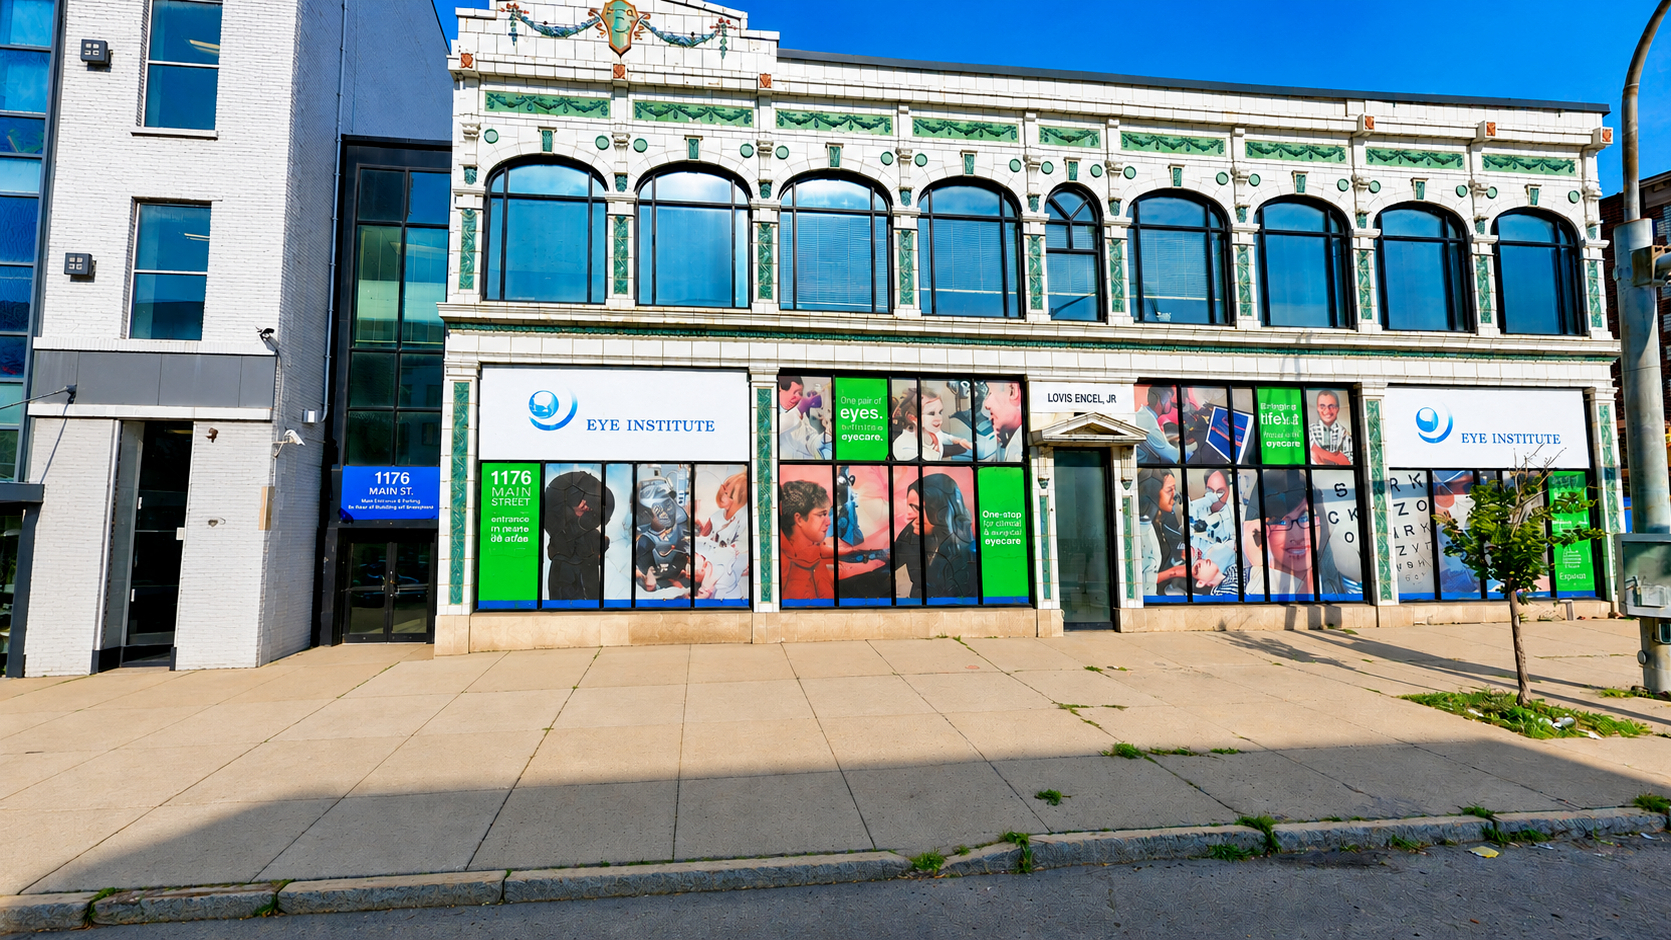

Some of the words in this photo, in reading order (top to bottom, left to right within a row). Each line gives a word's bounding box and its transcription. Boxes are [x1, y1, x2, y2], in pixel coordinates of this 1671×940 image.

[841, 396, 856, 405] One
[857, 396, 872, 406] pair
[873, 397, 882, 405] of
[1047, 393, 1073, 403] LOVIS
[1075, 393, 1105, 405] ENCEL,
[1106, 394, 1117, 404] JR
[840, 408, 883, 423] eyes.
[586, 419, 620, 431] EYE
[626, 419, 715, 432] INSTITUTE
[1461, 432, 1488, 444] EYE
[1492, 433, 1562, 445] INSTITUTE
[374, 471, 411, 485] 1176
[491, 470, 532, 485] 1176
[369, 487, 398, 496] MAIN
[400, 487, 414, 496] ST.
[491, 487, 532, 497] MAIN
[491, 497, 531, 507] STREET
